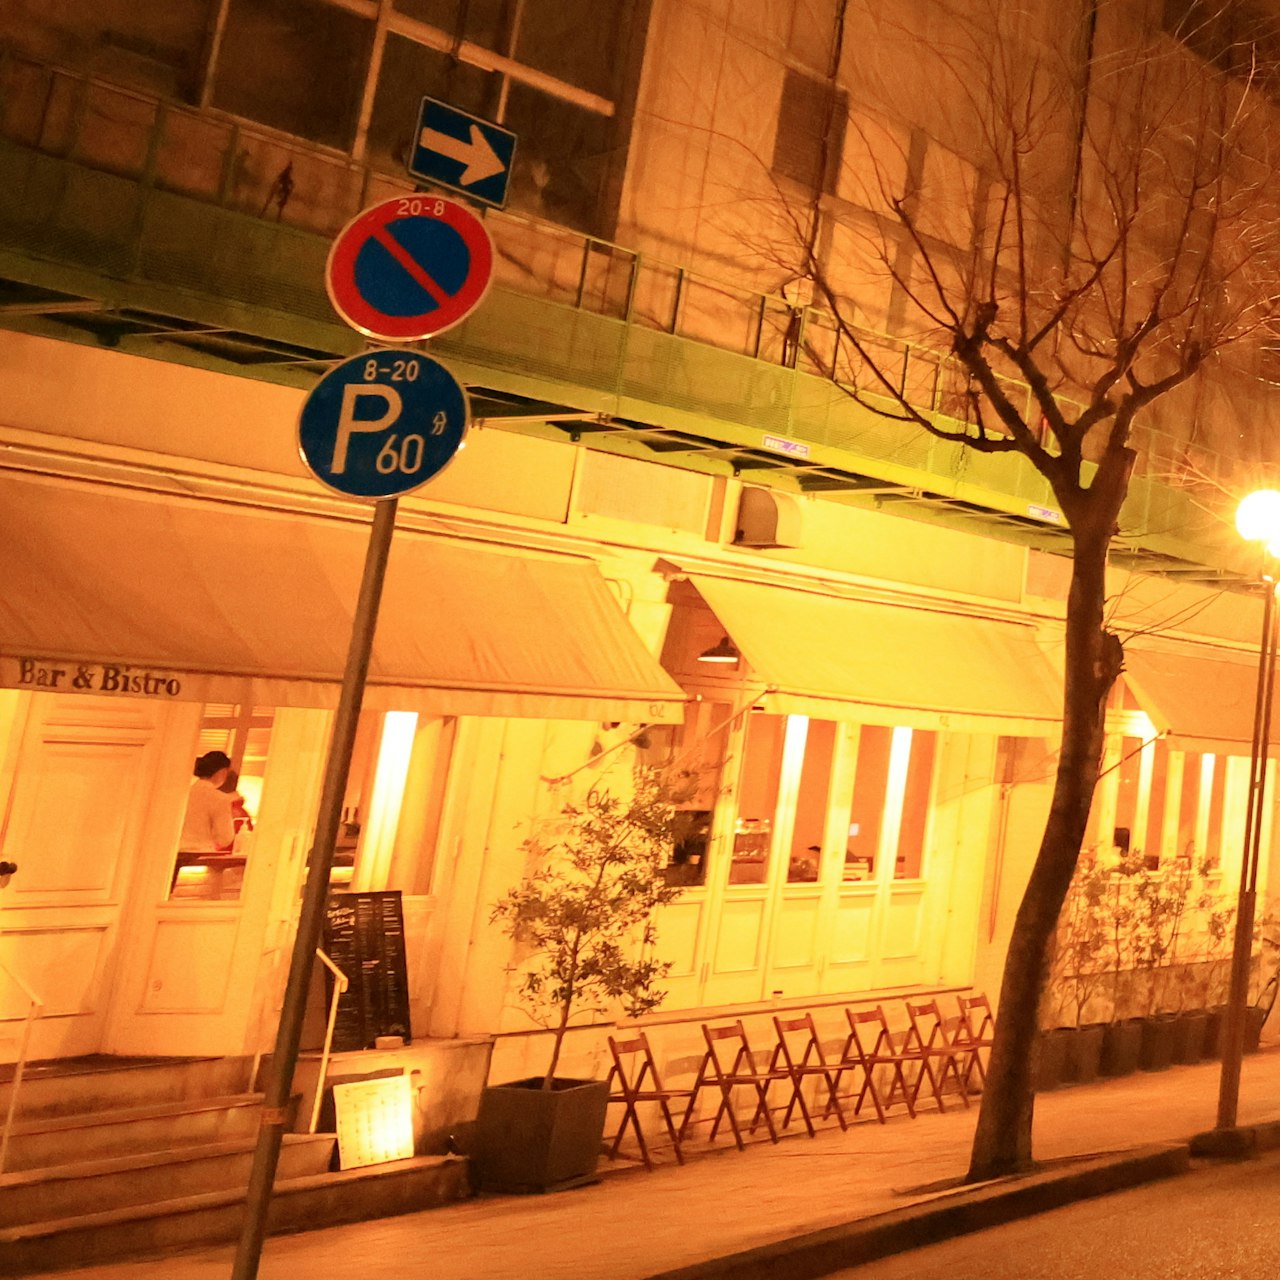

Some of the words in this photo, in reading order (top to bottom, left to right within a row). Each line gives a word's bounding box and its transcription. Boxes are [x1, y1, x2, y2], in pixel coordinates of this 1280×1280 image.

[397, 199, 445, 217] 20-8
[363, 359, 419, 382] 8-20
[329, 383, 403, 474] P
[375, 433, 425, 474] 60
[18, 656, 66, 688] Bar
[72, 665, 96, 690] &
[100, 663, 182, 697] Bistro
